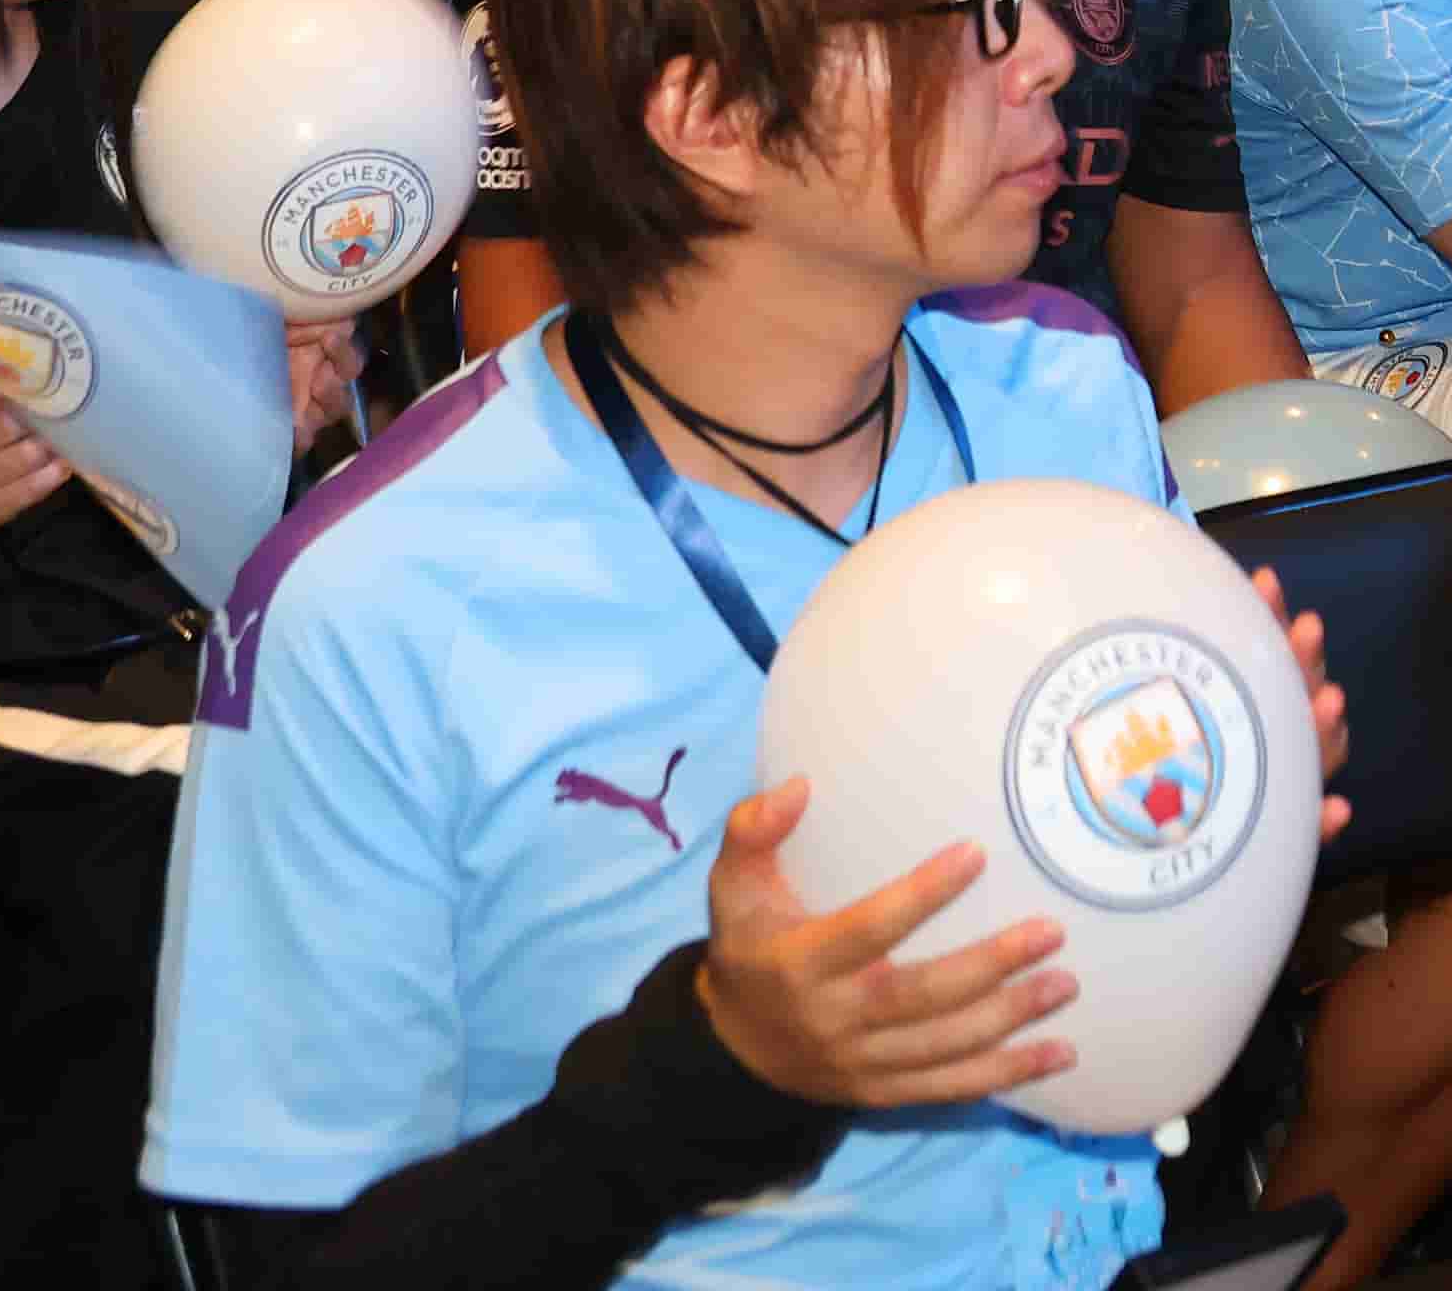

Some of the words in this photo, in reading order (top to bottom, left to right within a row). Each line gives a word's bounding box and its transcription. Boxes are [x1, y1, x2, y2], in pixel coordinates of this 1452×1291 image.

[285, 164, 418, 227] MANCHESTER
[327, 274, 375, 292] CITY
[1032, 641, 1216, 769] MANCHESTER
[1148, 839, 1216, 884] CITY
